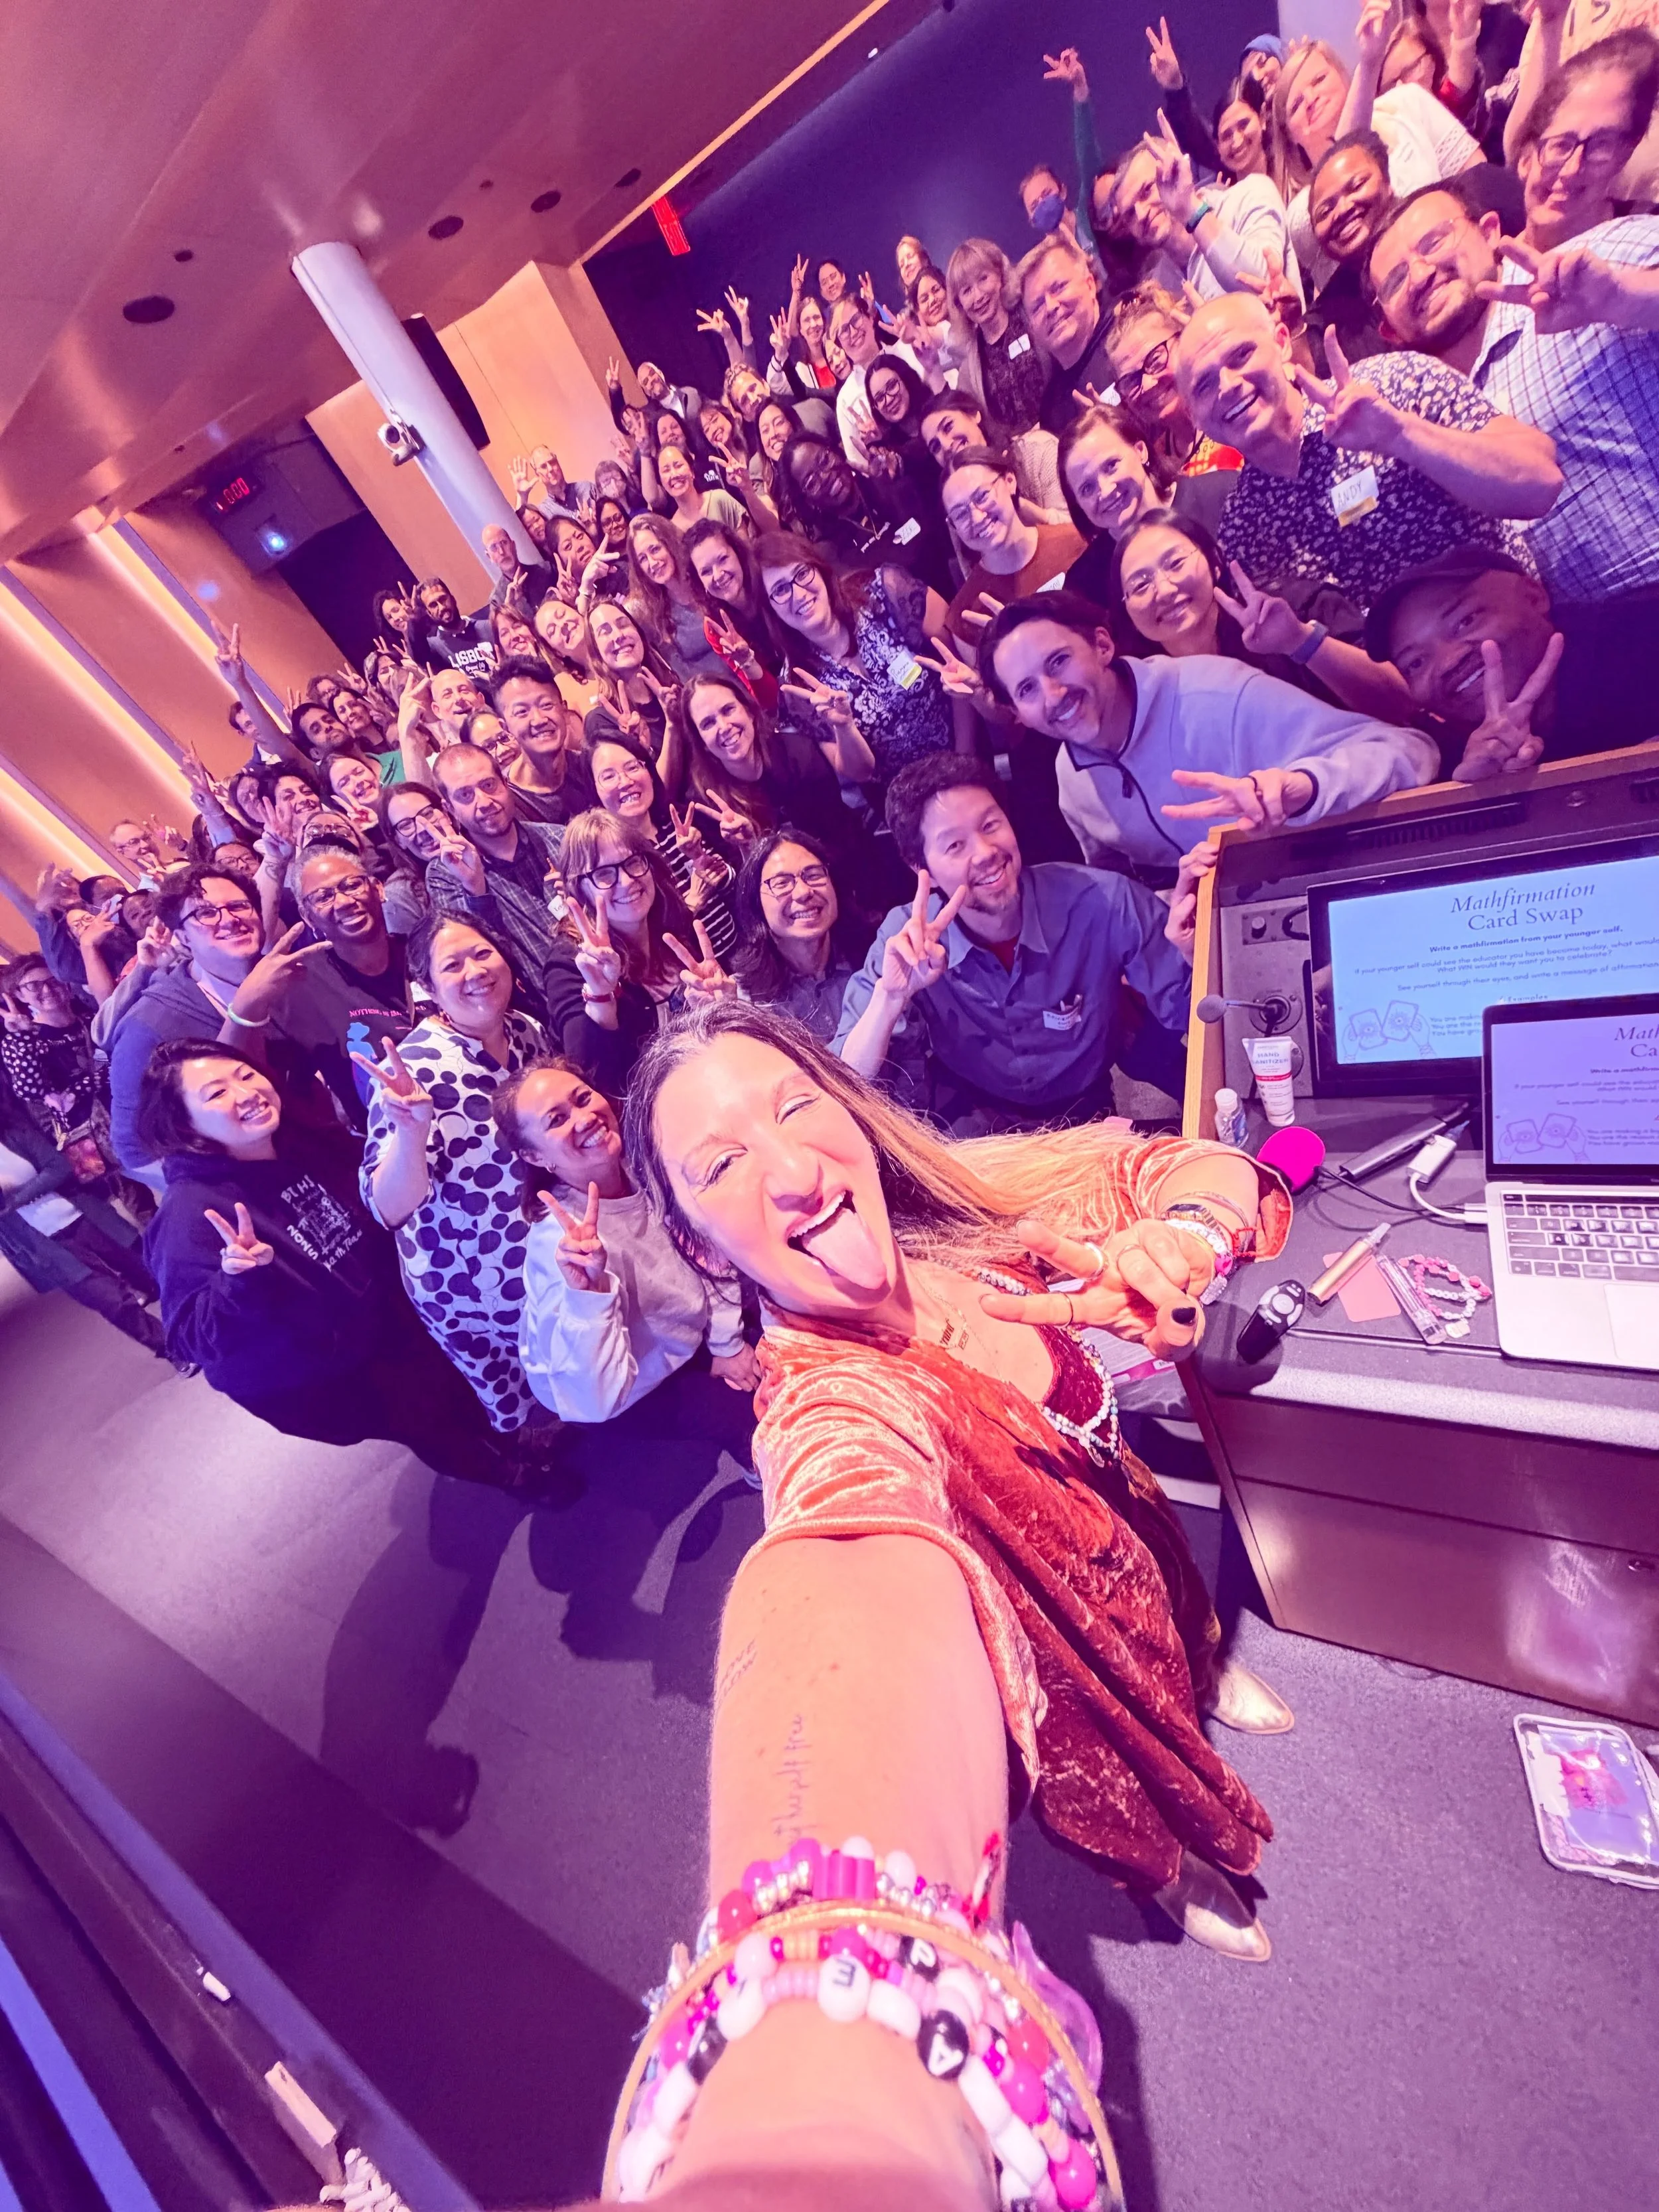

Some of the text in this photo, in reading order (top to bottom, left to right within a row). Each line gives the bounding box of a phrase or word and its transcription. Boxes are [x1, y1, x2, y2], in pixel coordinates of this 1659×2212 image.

[1451, 883, 1595, 913] Mathfirmation
[1468, 907, 1583, 930] Card Swap
[1461, 939, 1520, 949] mathfirmation
[1543, 934, 1562, 942] your
[1564, 929, 1601, 940] younger
[1377, 966, 1405, 974] younger
